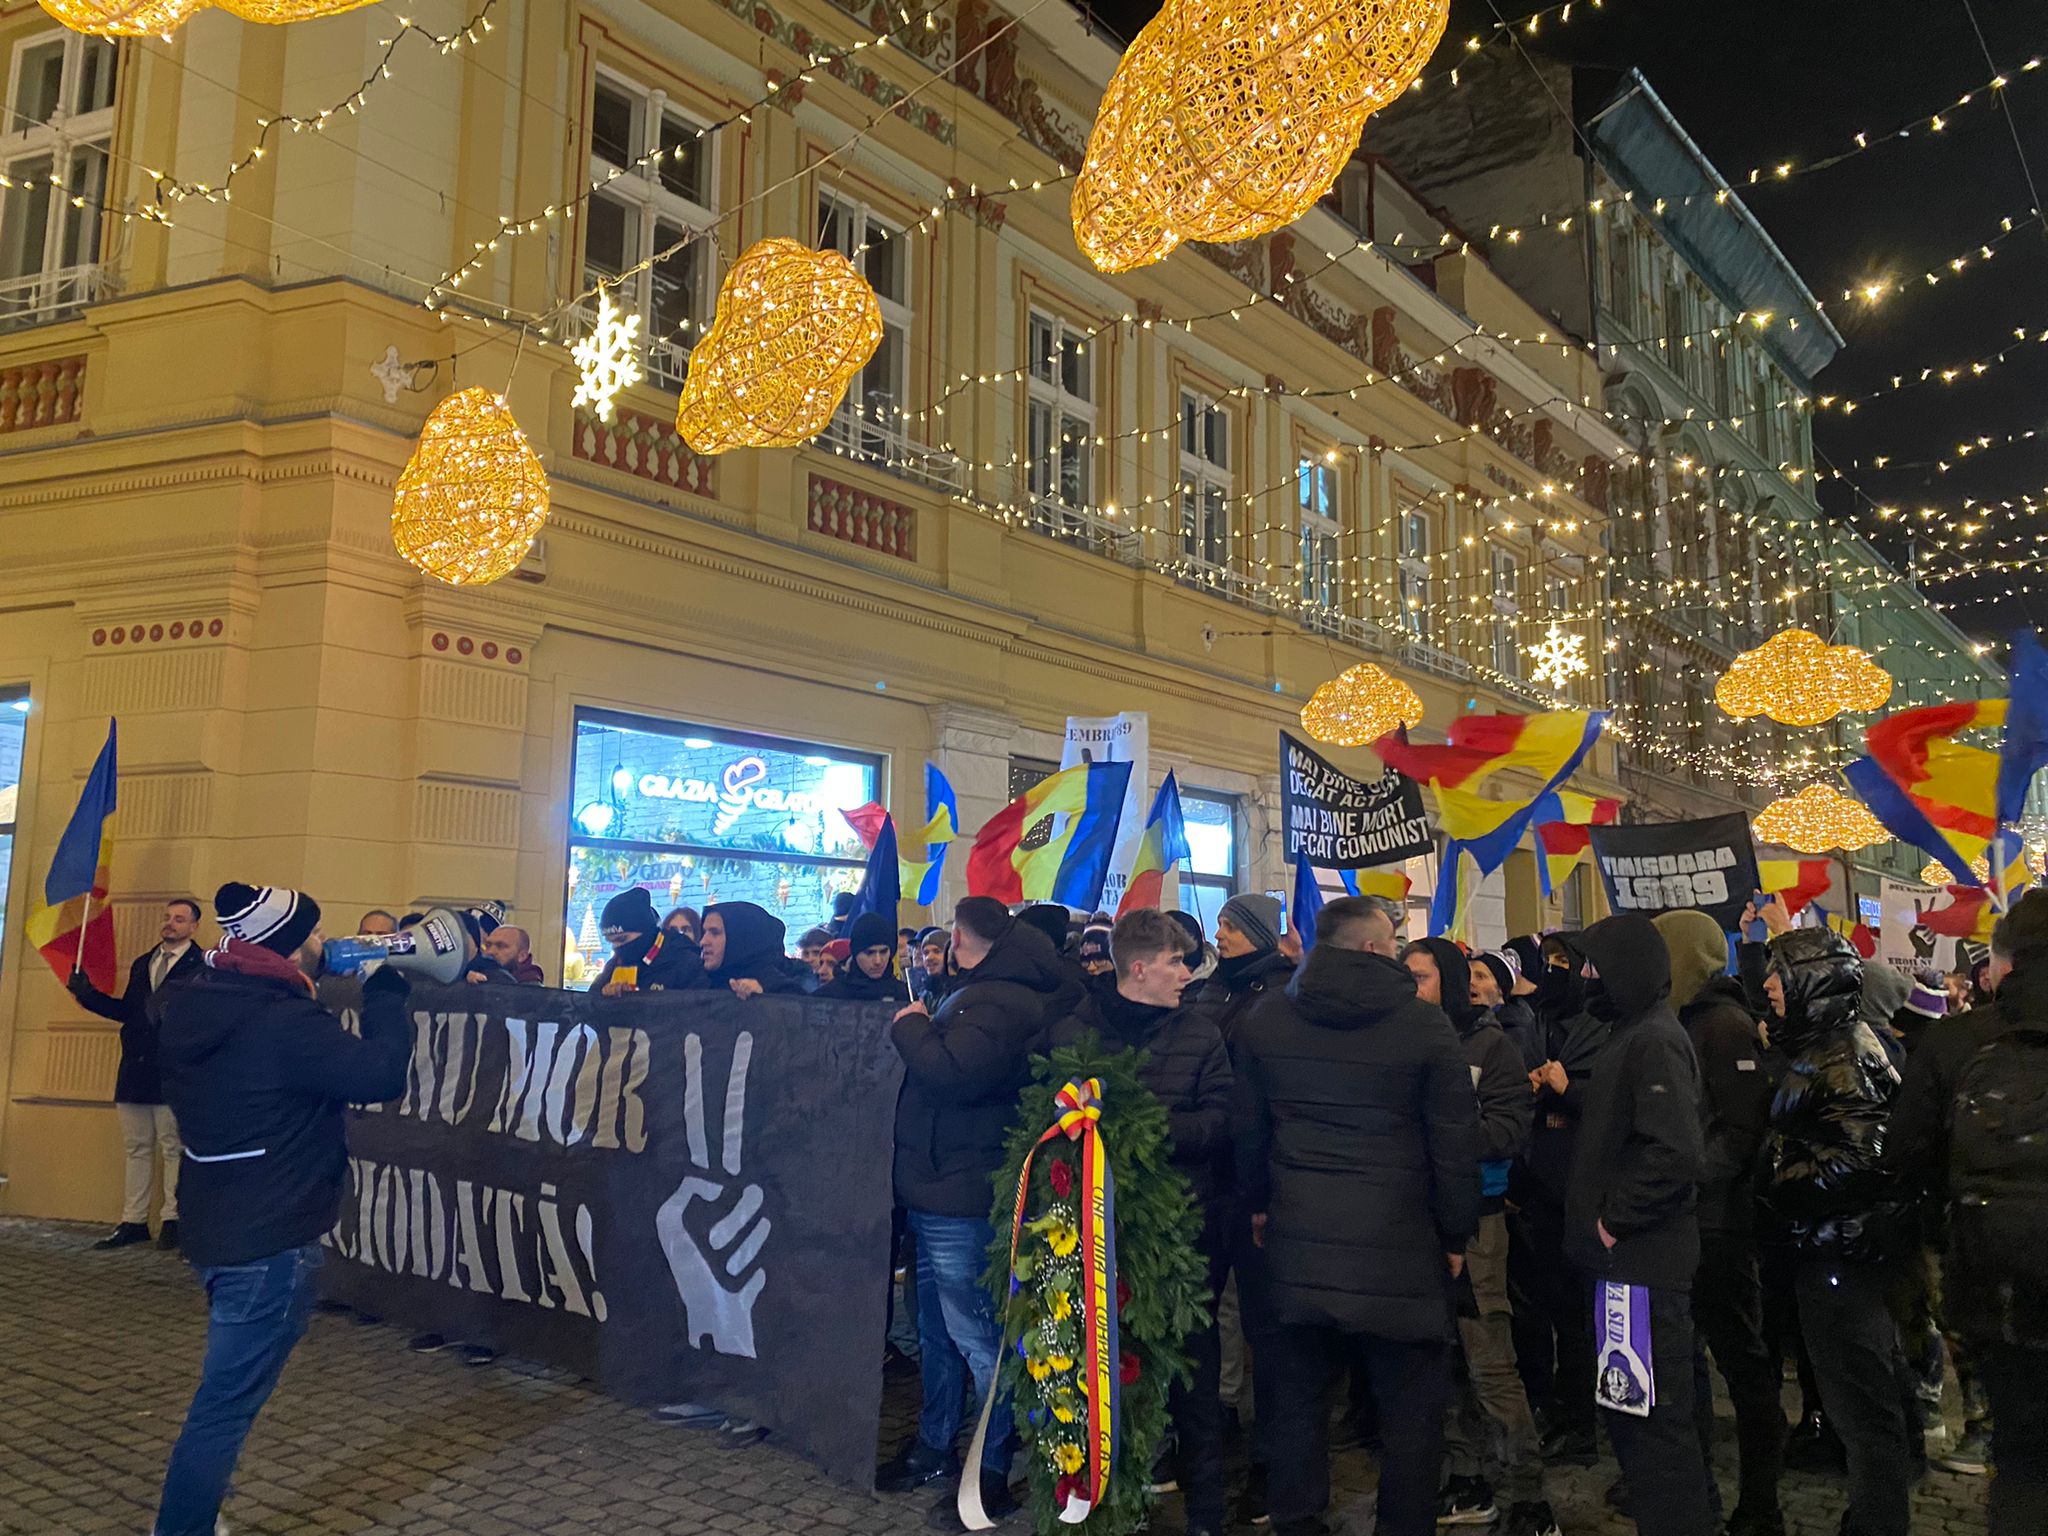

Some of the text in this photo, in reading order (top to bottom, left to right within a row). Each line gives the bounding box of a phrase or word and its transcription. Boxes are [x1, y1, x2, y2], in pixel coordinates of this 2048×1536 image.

[1288, 745, 1318, 778] MAI
[1290, 796, 1406, 836] MAI BINE MORT
[1336, 817, 1429, 860] COMUNIST
[487, 1018, 651, 1154] MOR
[1608, 1309, 1625, 1344] SUD
